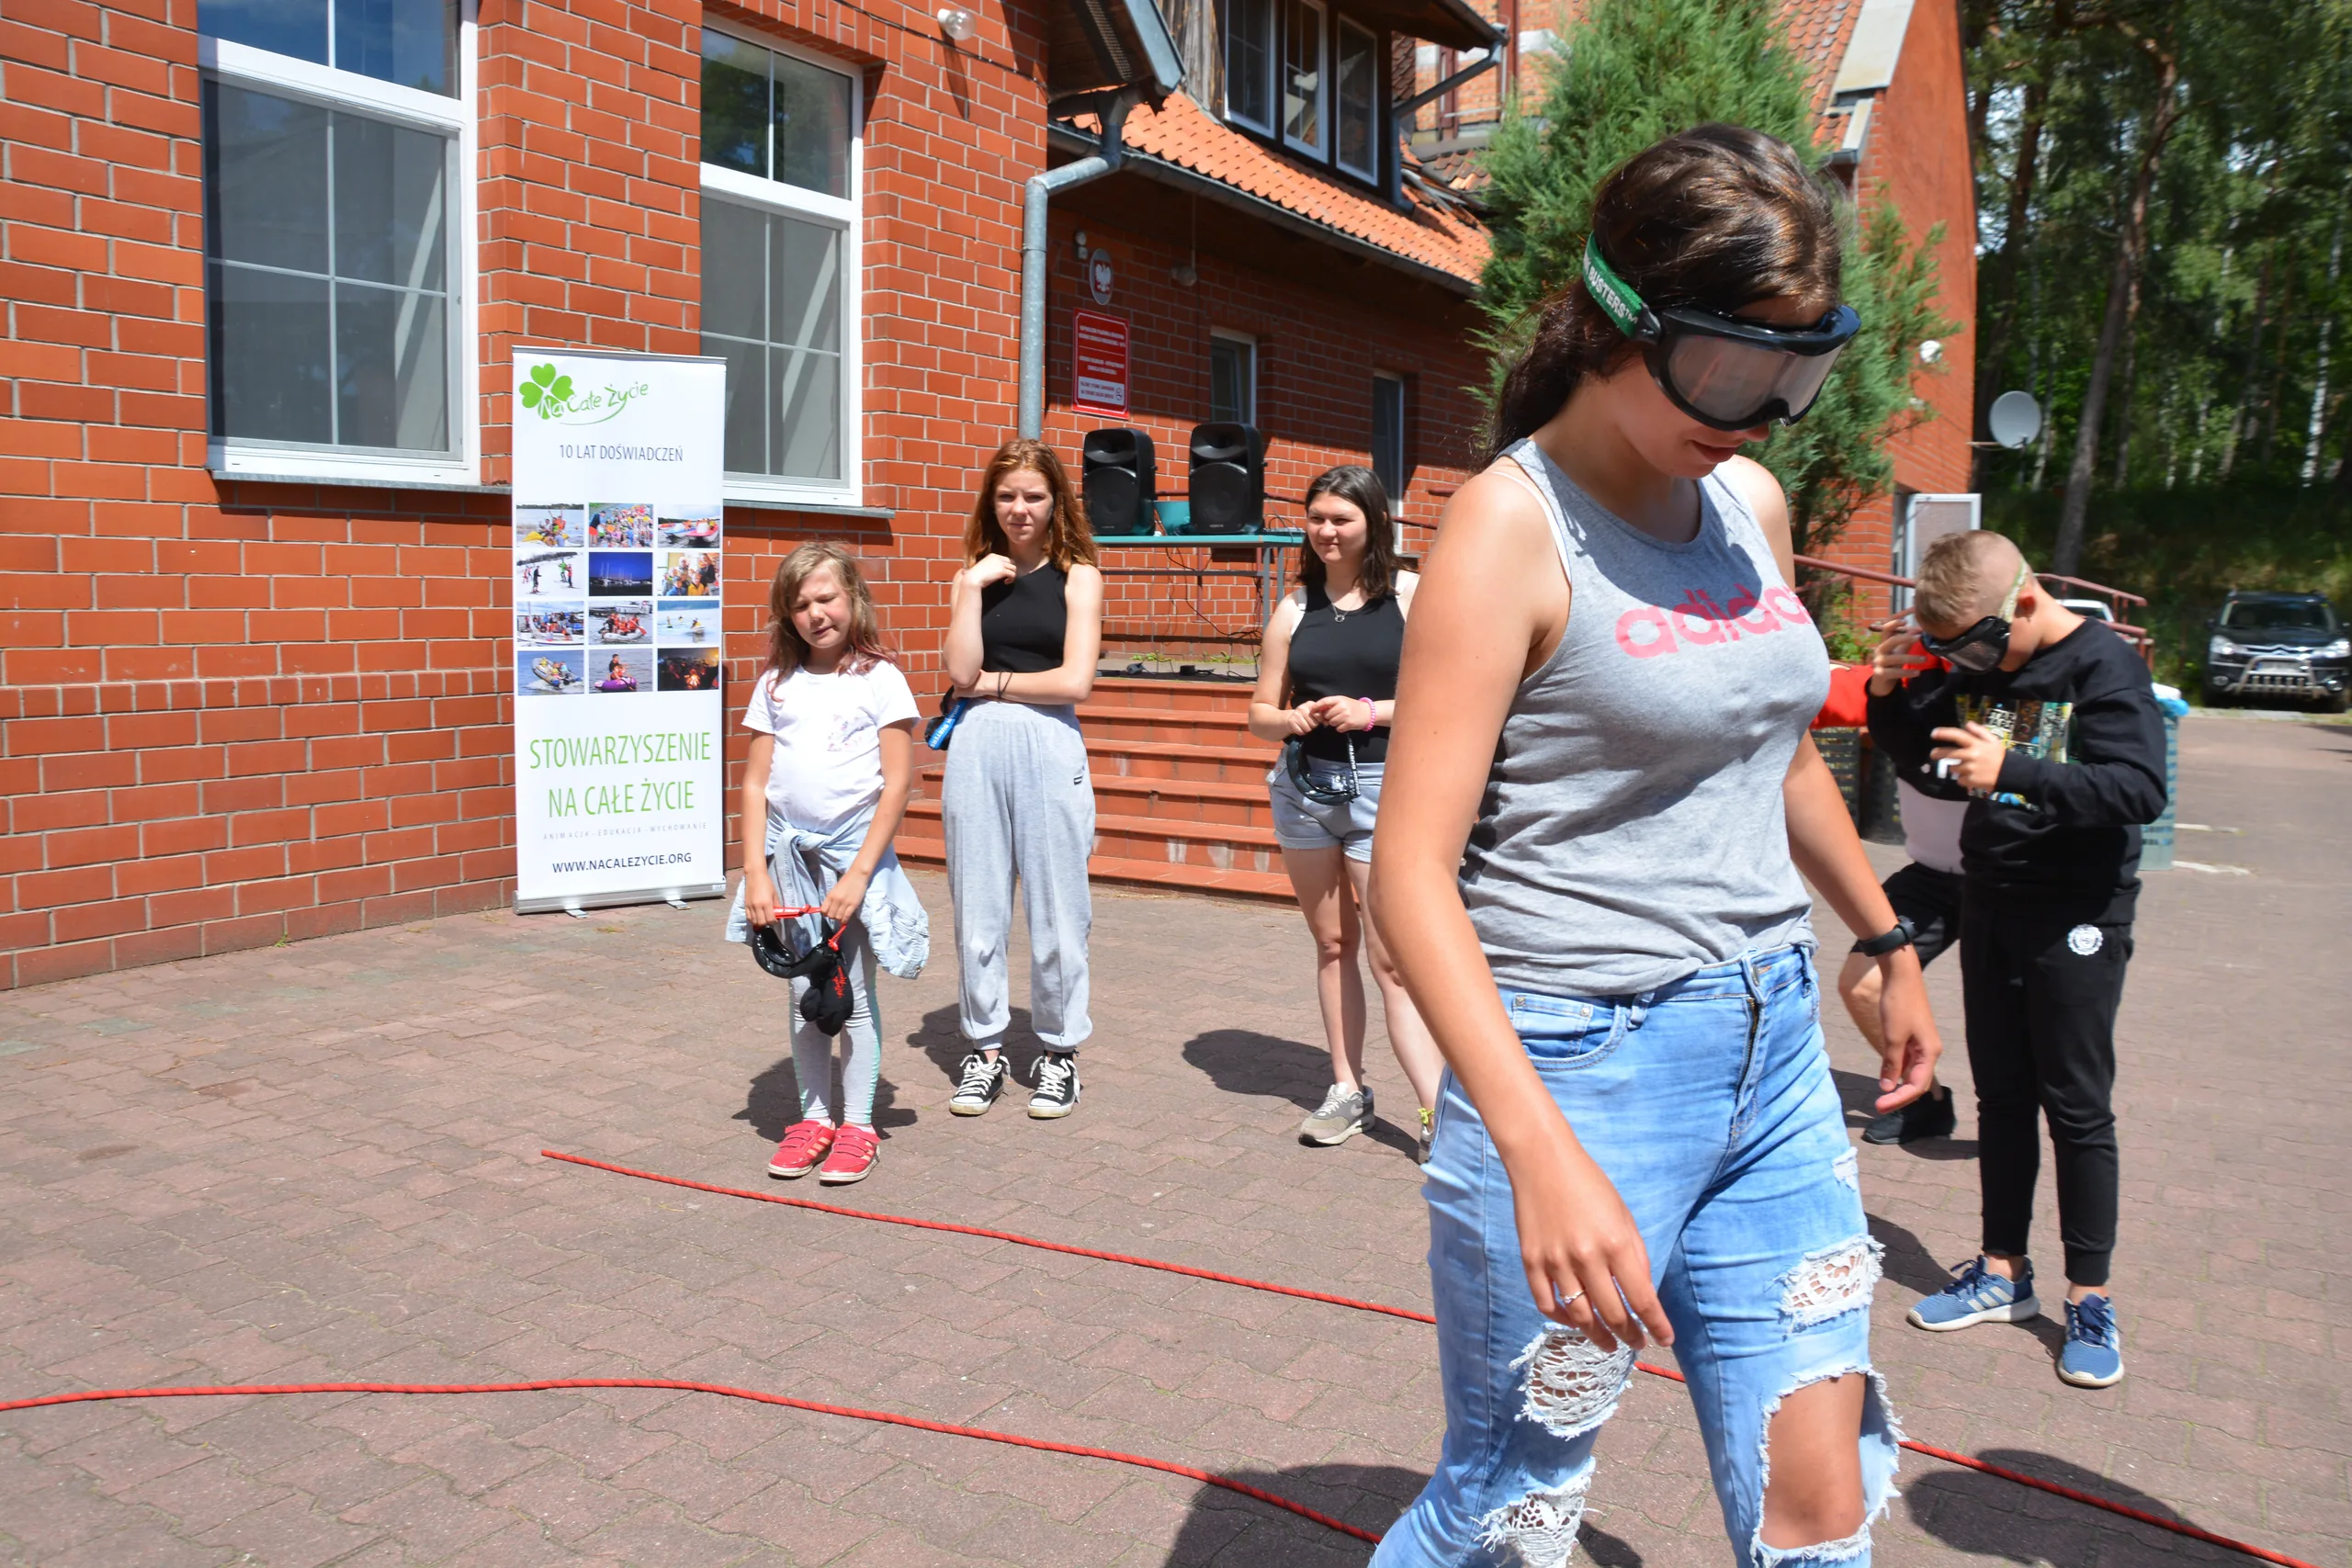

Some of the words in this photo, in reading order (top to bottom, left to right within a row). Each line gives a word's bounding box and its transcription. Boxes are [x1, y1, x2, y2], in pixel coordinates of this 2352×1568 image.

[604, 381, 649, 411] Życie
[560, 445, 573, 458] 10
[576, 445, 596, 458] LAT
[600, 443, 683, 461] DOŚWIADCZEŃ
[1615, 583, 1811, 659] adida
[529, 732, 711, 769] STOWARZYSZENIE
[548, 787, 578, 818] NA
[584, 783, 635, 815] CAŁE
[640, 778, 695, 811] ŻYCIE
[552, 852, 692, 874] WWW.NACALEZYCIE.ORG
